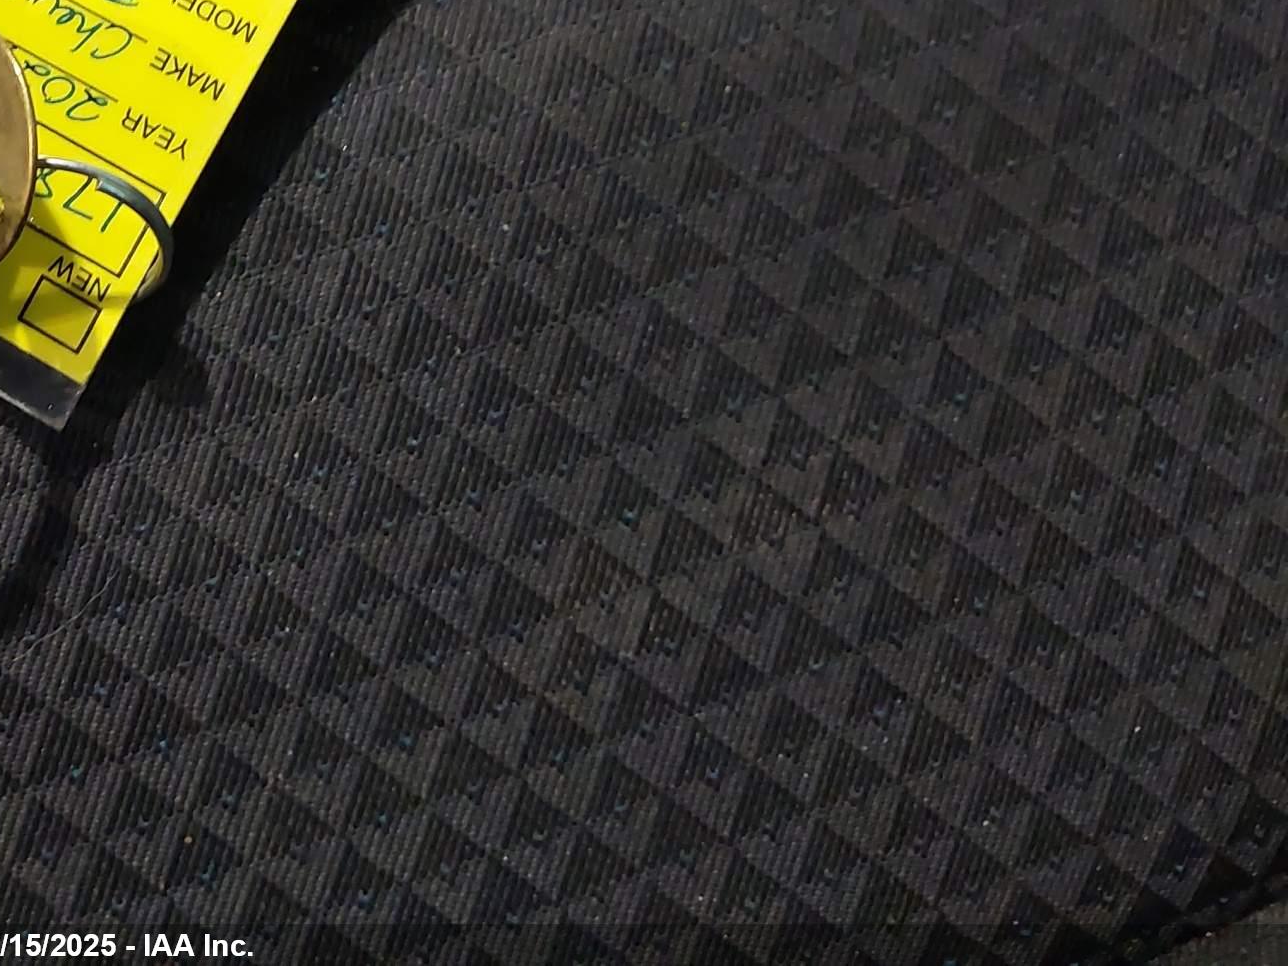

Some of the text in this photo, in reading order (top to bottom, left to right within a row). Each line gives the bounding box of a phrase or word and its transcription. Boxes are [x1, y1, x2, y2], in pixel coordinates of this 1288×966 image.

[148, 46, 226, 102] MAKE
[118, 105, 188, 161] YEAR
[46, 254, 112, 302] NEW
